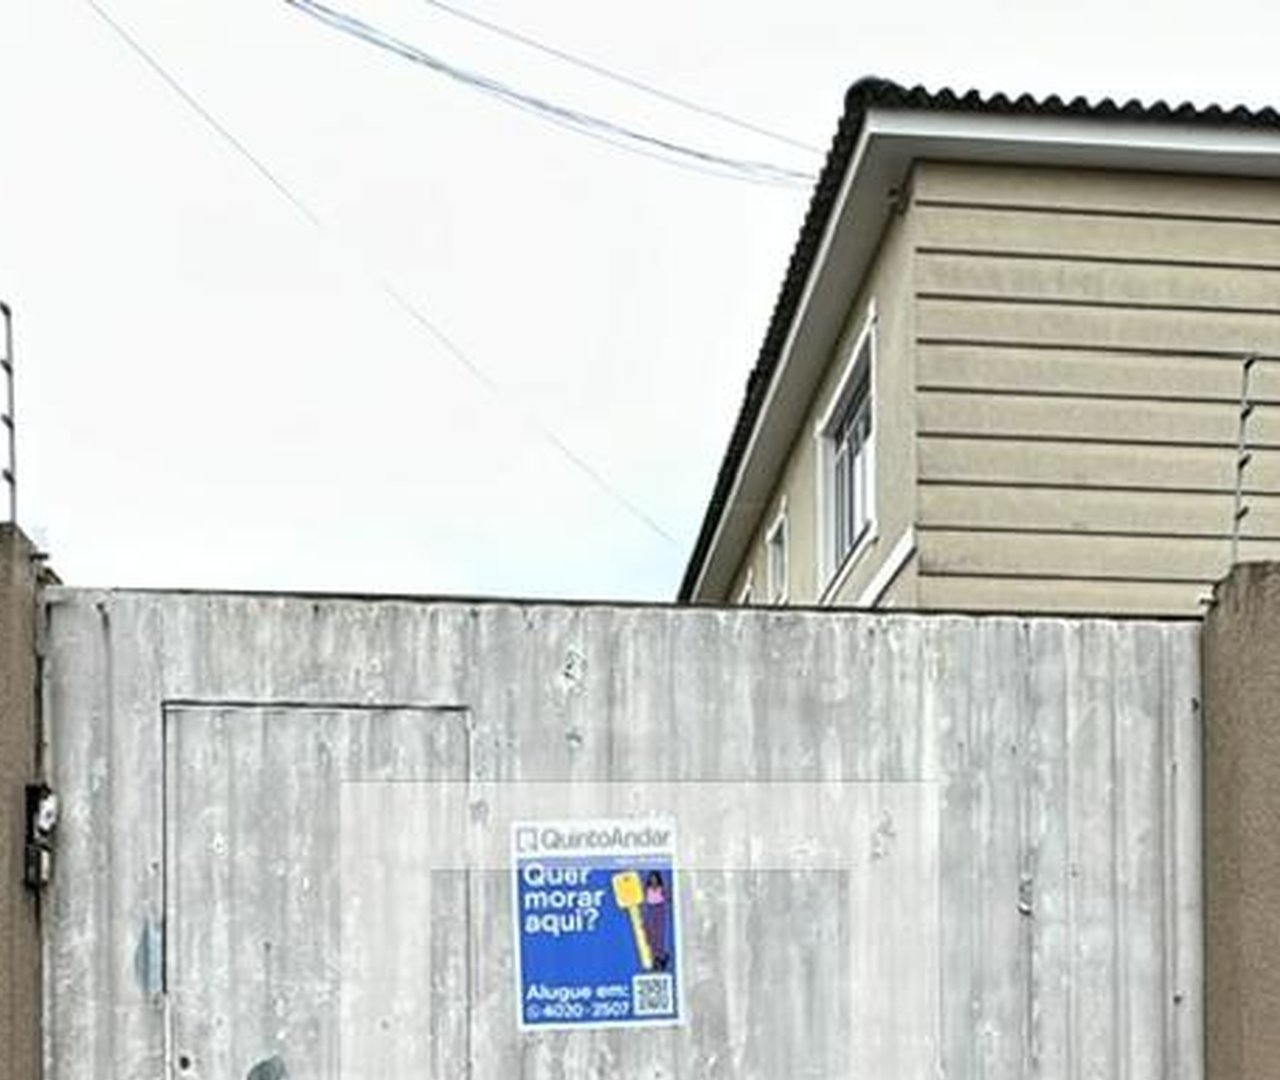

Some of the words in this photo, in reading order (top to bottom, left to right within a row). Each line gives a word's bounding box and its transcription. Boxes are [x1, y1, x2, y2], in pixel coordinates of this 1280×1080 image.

[540, 827, 669, 849] QuintoAndar
[524, 862, 590, 887] Quer
[524, 890, 604, 909] morar
[524, 909, 599, 936] aqui?
[526, 984, 592, 1001] Alugue
[596, 985, 629, 999] em:
